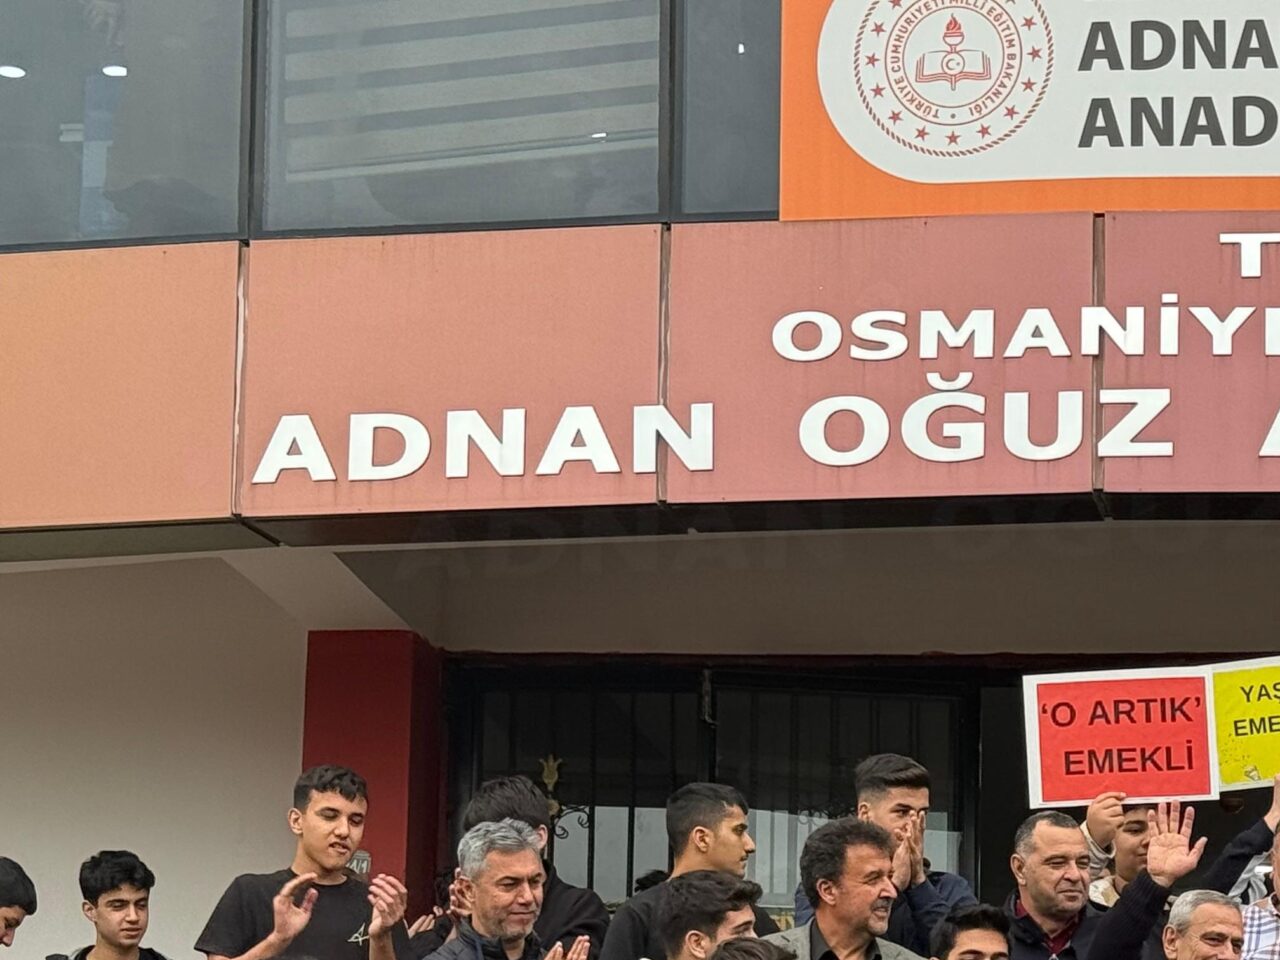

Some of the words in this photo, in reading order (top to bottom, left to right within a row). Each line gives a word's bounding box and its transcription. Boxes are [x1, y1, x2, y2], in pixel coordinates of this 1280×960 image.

[968, 53, 1017, 117] BAKANLIĞI
[252, 402, 714, 483] ADNAN
[799, 371, 1174, 466] OĞUZ
[1064, 739, 1194, 776] EMEKLİ
